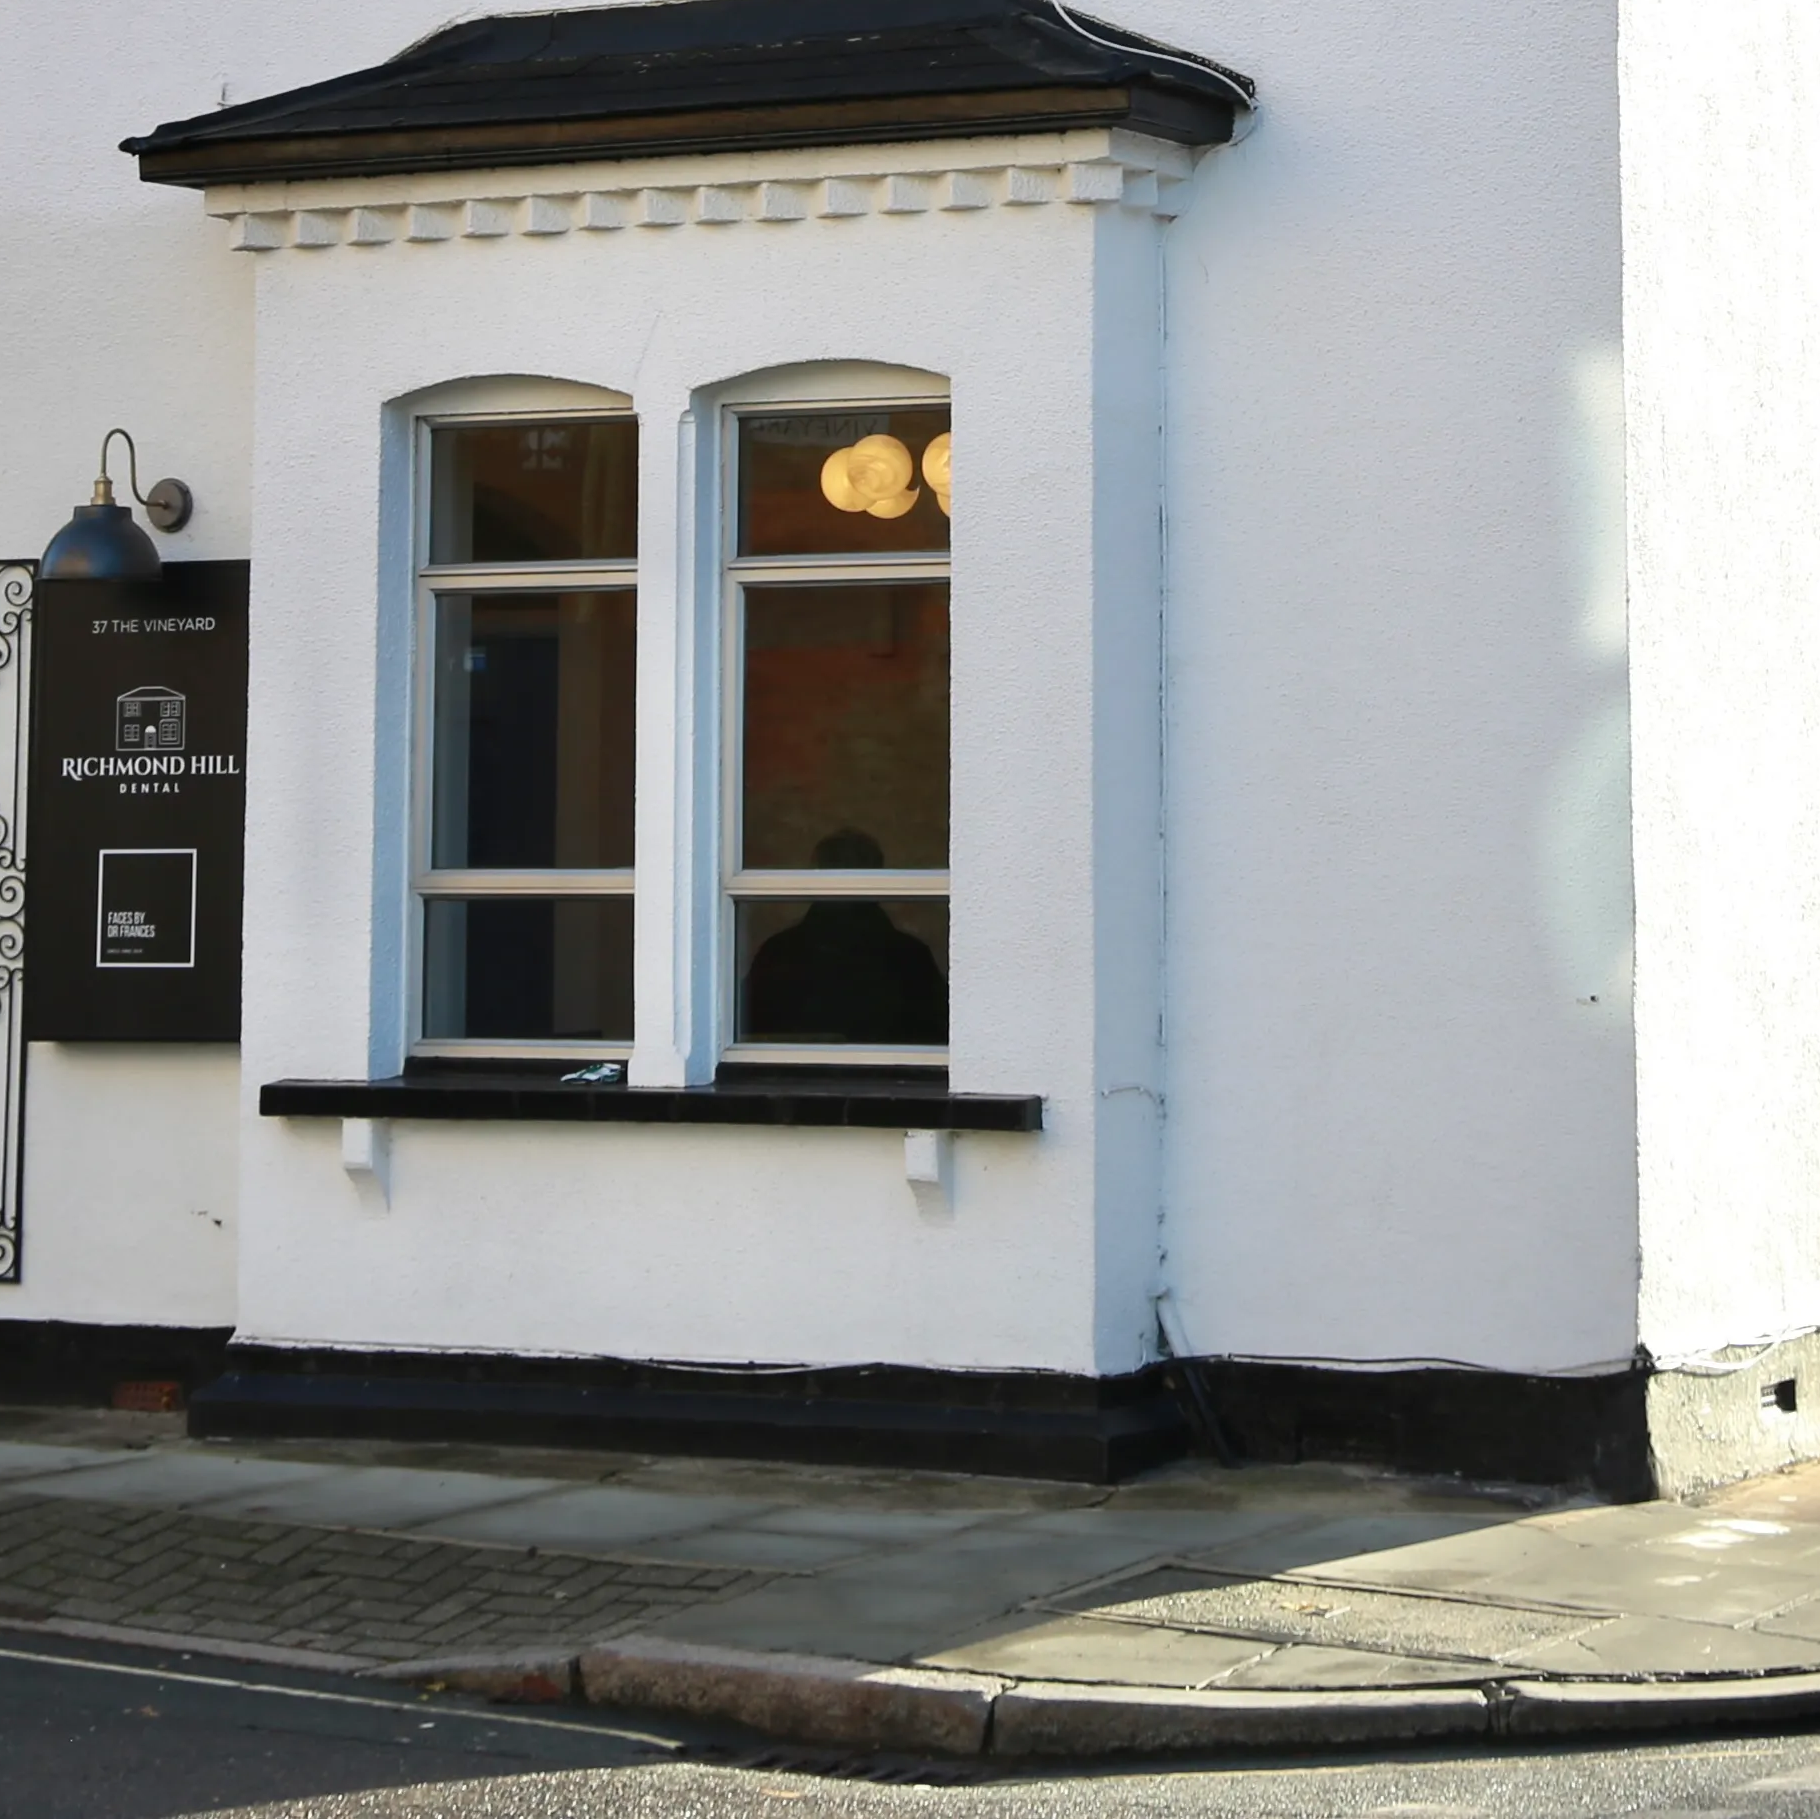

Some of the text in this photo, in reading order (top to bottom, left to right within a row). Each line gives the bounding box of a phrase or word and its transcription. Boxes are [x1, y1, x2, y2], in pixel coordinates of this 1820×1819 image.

[91, 617, 216, 634] 37 THE VINEYARD
[61, 755, 240, 781] RICHMOND HILL
[119, 782, 181, 794] DENTAL
[108, 911, 146, 924] FACES BY
[107, 925, 155, 937] DR FRANCES
